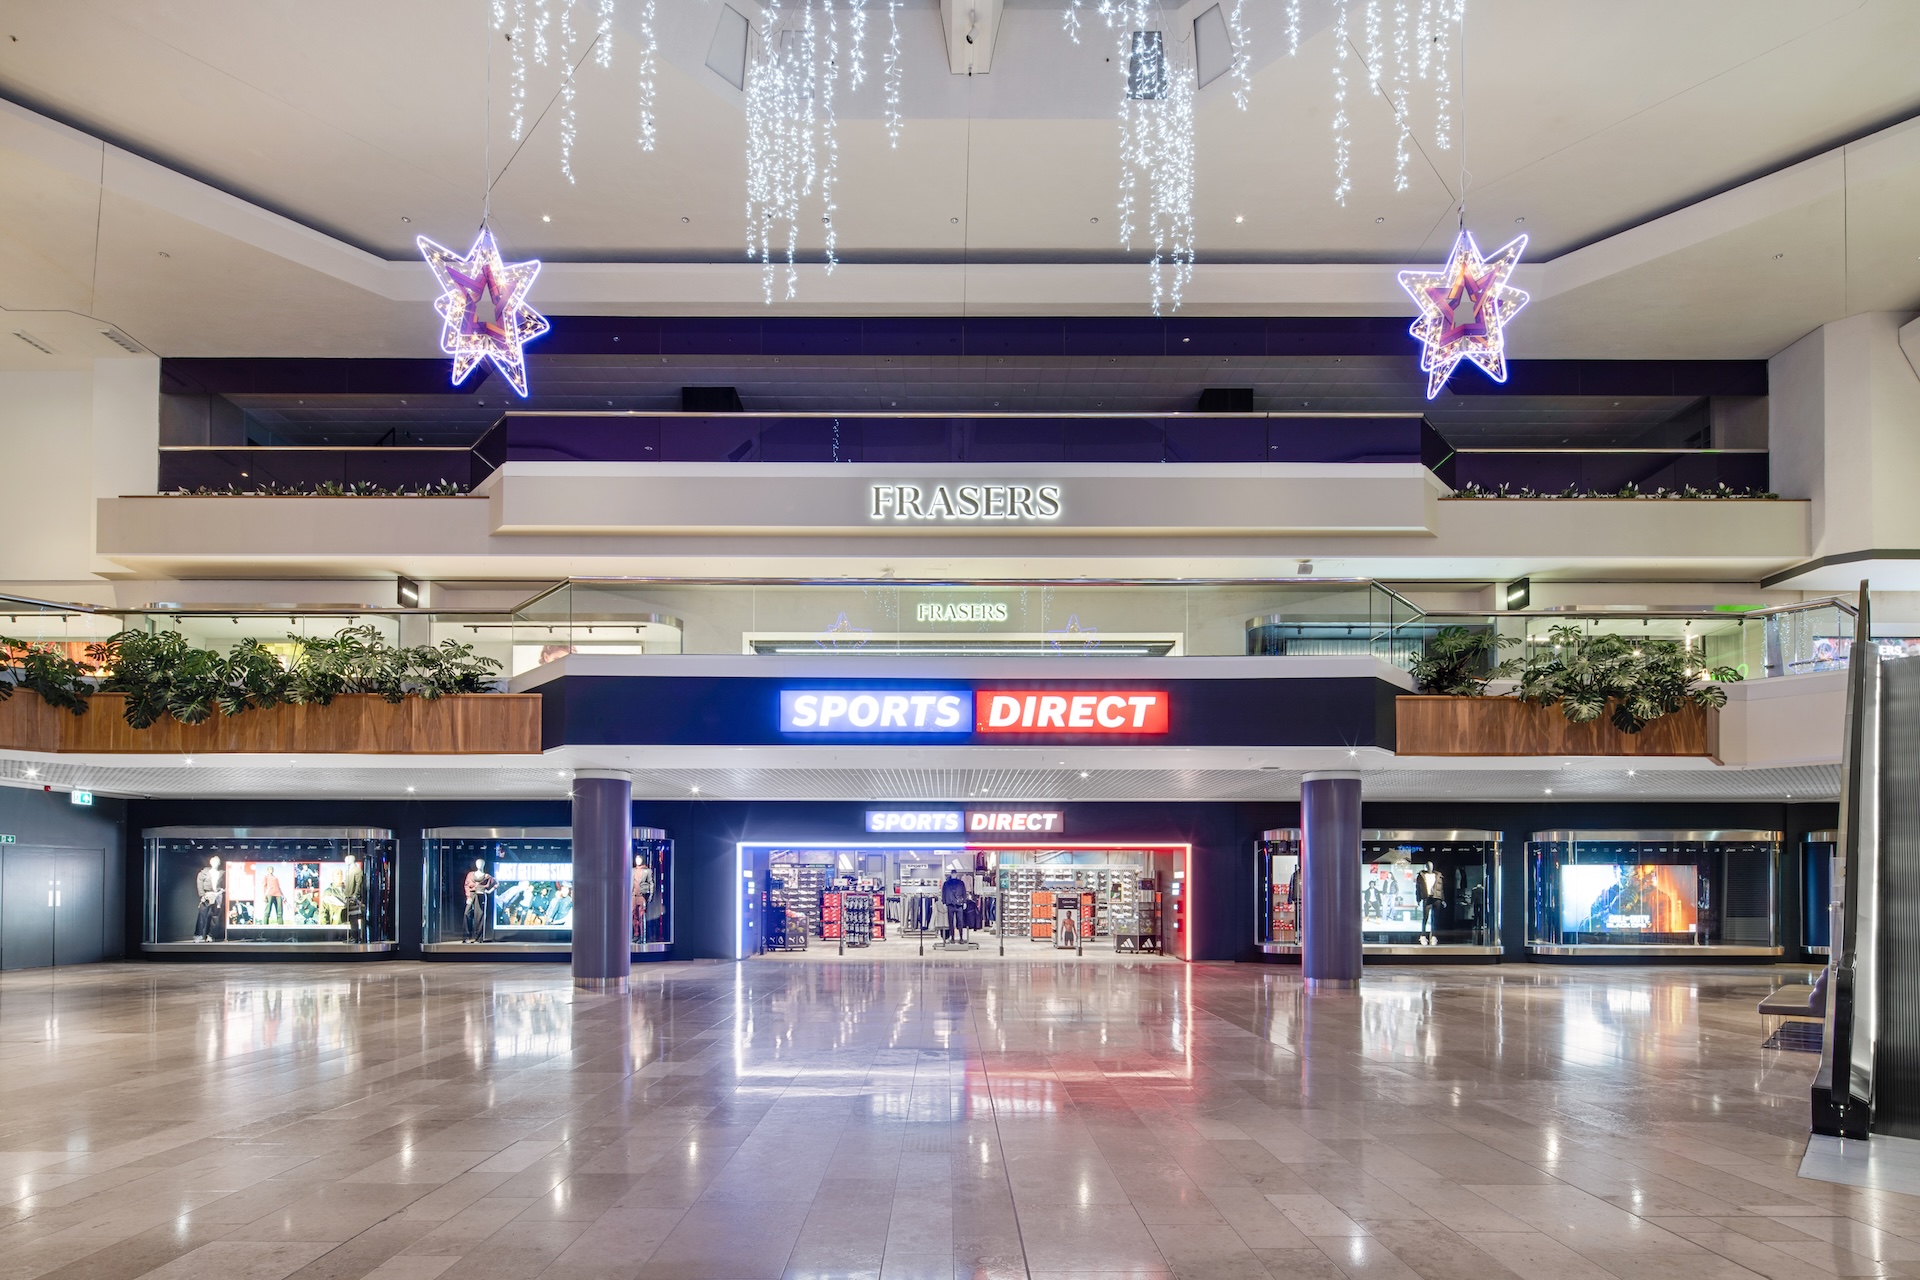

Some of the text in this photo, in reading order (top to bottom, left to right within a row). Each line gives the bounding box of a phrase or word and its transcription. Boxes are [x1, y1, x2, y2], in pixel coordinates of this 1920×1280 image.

[870, 486, 1061, 518] FRASERS
[917, 603, 1008, 622] FRASERS
[792, 694, 1156, 728] SPORTS DIRECT
[871, 813, 1058, 831] SPORTS DIRECT
